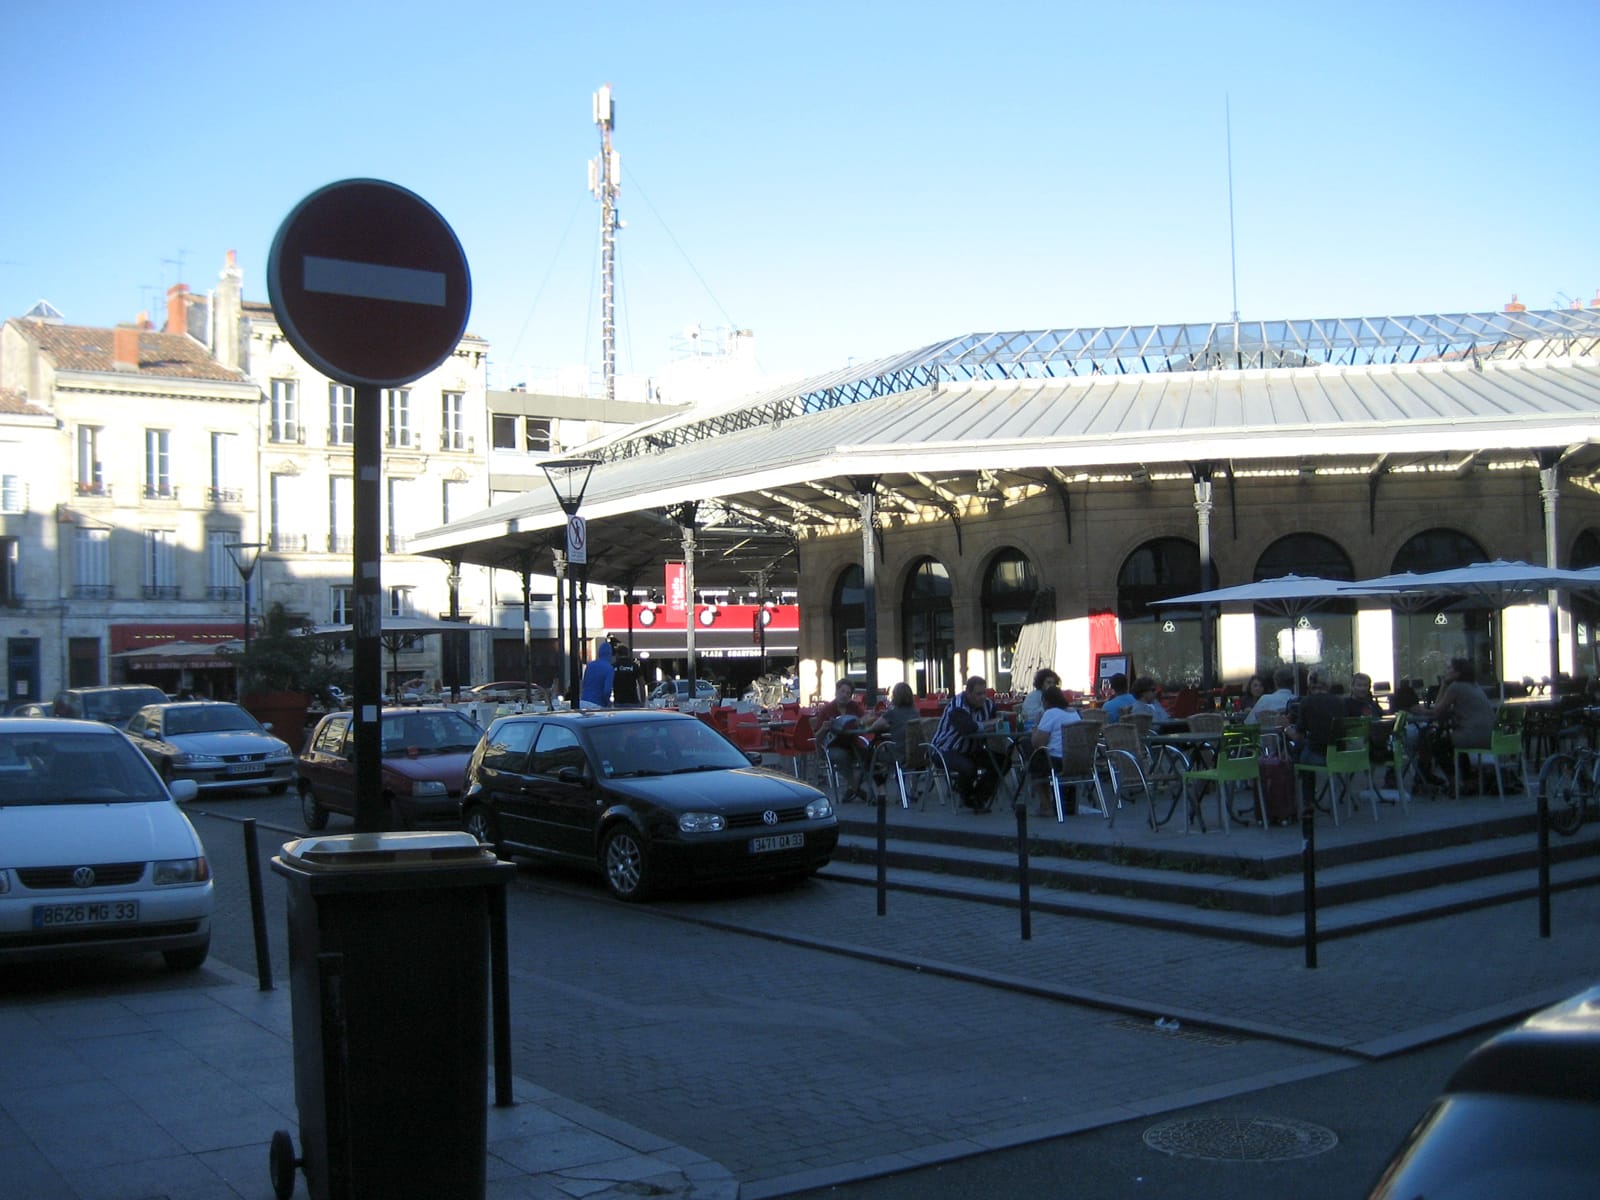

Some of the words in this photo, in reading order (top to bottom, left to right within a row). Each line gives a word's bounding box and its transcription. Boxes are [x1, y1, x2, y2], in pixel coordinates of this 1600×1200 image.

[755, 837, 776, 850] 3471
[792, 834, 803, 846] 33
[43, 906, 85, 924] 8626
[88, 905, 109, 921] MG
[114, 903, 136, 919] 33
